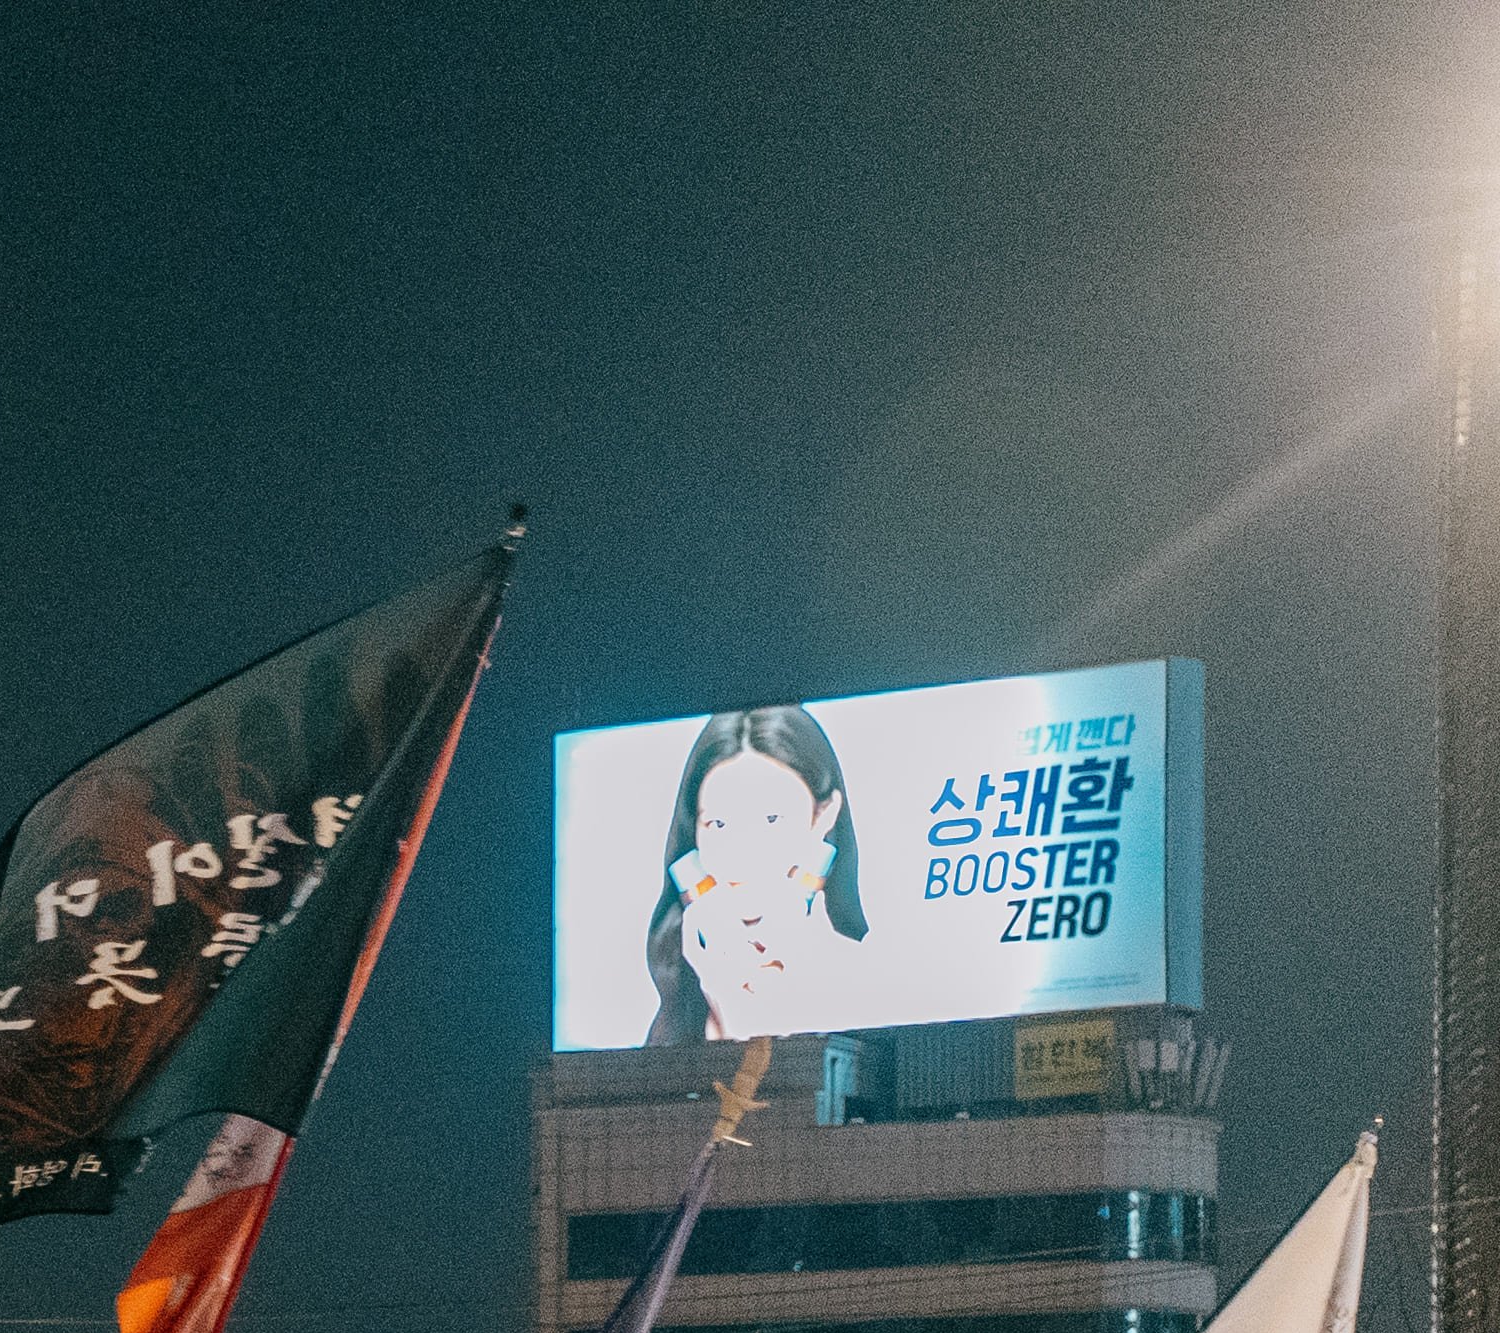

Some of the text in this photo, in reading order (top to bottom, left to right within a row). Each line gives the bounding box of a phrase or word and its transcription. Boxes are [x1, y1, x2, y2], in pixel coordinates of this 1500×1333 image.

[1077, 714, 1137, 749] 깬다
[927, 755, 1136, 849] 상쾌환
[924, 839, 1121, 901] BOOSTER
[1000, 889, 1111, 944] ZERO
